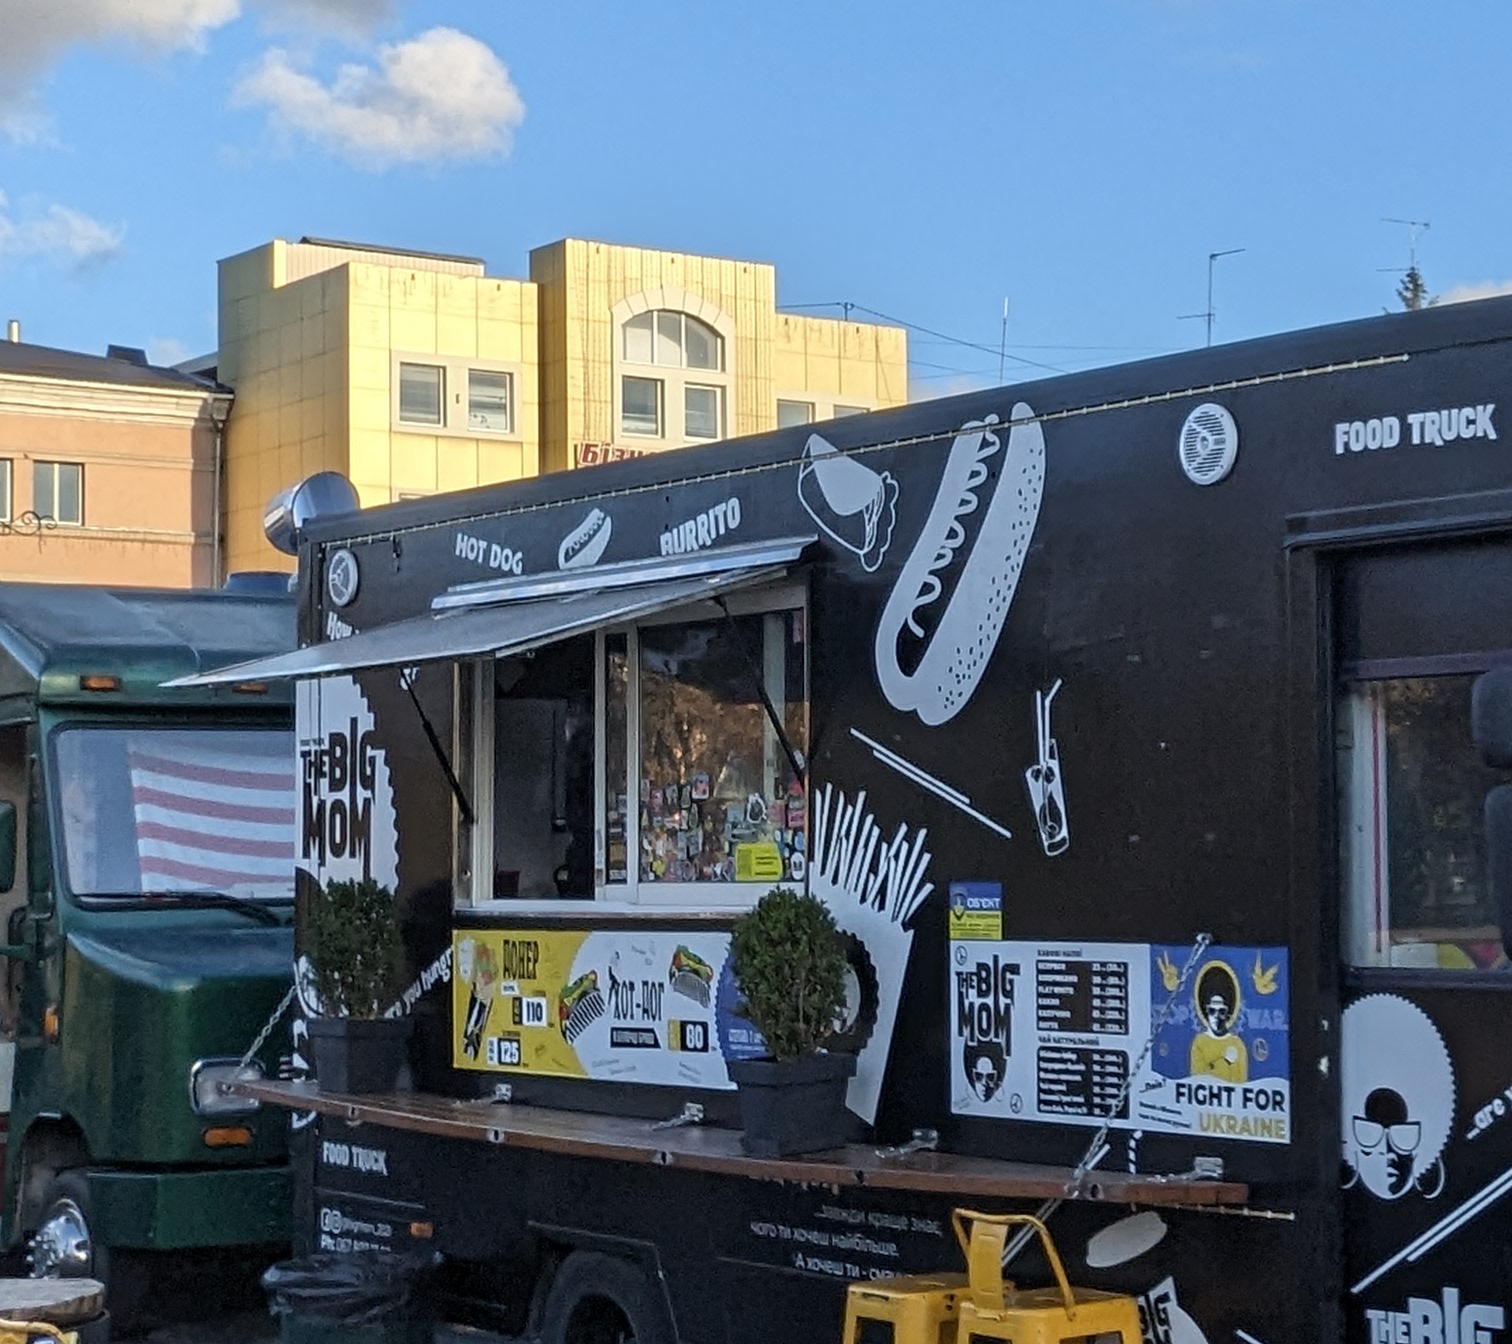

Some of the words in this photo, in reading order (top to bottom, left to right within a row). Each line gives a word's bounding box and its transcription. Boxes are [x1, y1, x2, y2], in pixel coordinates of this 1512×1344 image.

[1335, 416, 1400, 455] FOOD
[1407, 404, 1498, 447] TRUCK
[660, 497, 742, 556] BURRITO
[455, 533, 486, 564] HOT
[488, 547, 524, 575] DOG
[328, 717, 386, 804] BIG
[303, 784, 371, 879] MOM
[503, 939, 539, 980] ДОНЕР
[955, 971, 978, 1000] THE
[976, 954, 1021, 1006] BIG
[525, 1001, 543, 1022] 110
[958, 1000, 1012, 1058] MOM
[500, 1041, 520, 1066] 125
[1175, 1083, 1235, 1109] FIGHT
[1242, 1086, 1286, 1113] FOR
[1199, 1113, 1286, 1140] UKRAINE
[322, 1140, 350, 1167] FOOD
[351, 1145, 388, 1176] TRUCK
[795, 1253, 805, 1268] А
[806, 1257, 844, 1276] хочеш
[845, 1262, 860, 1278] ти
